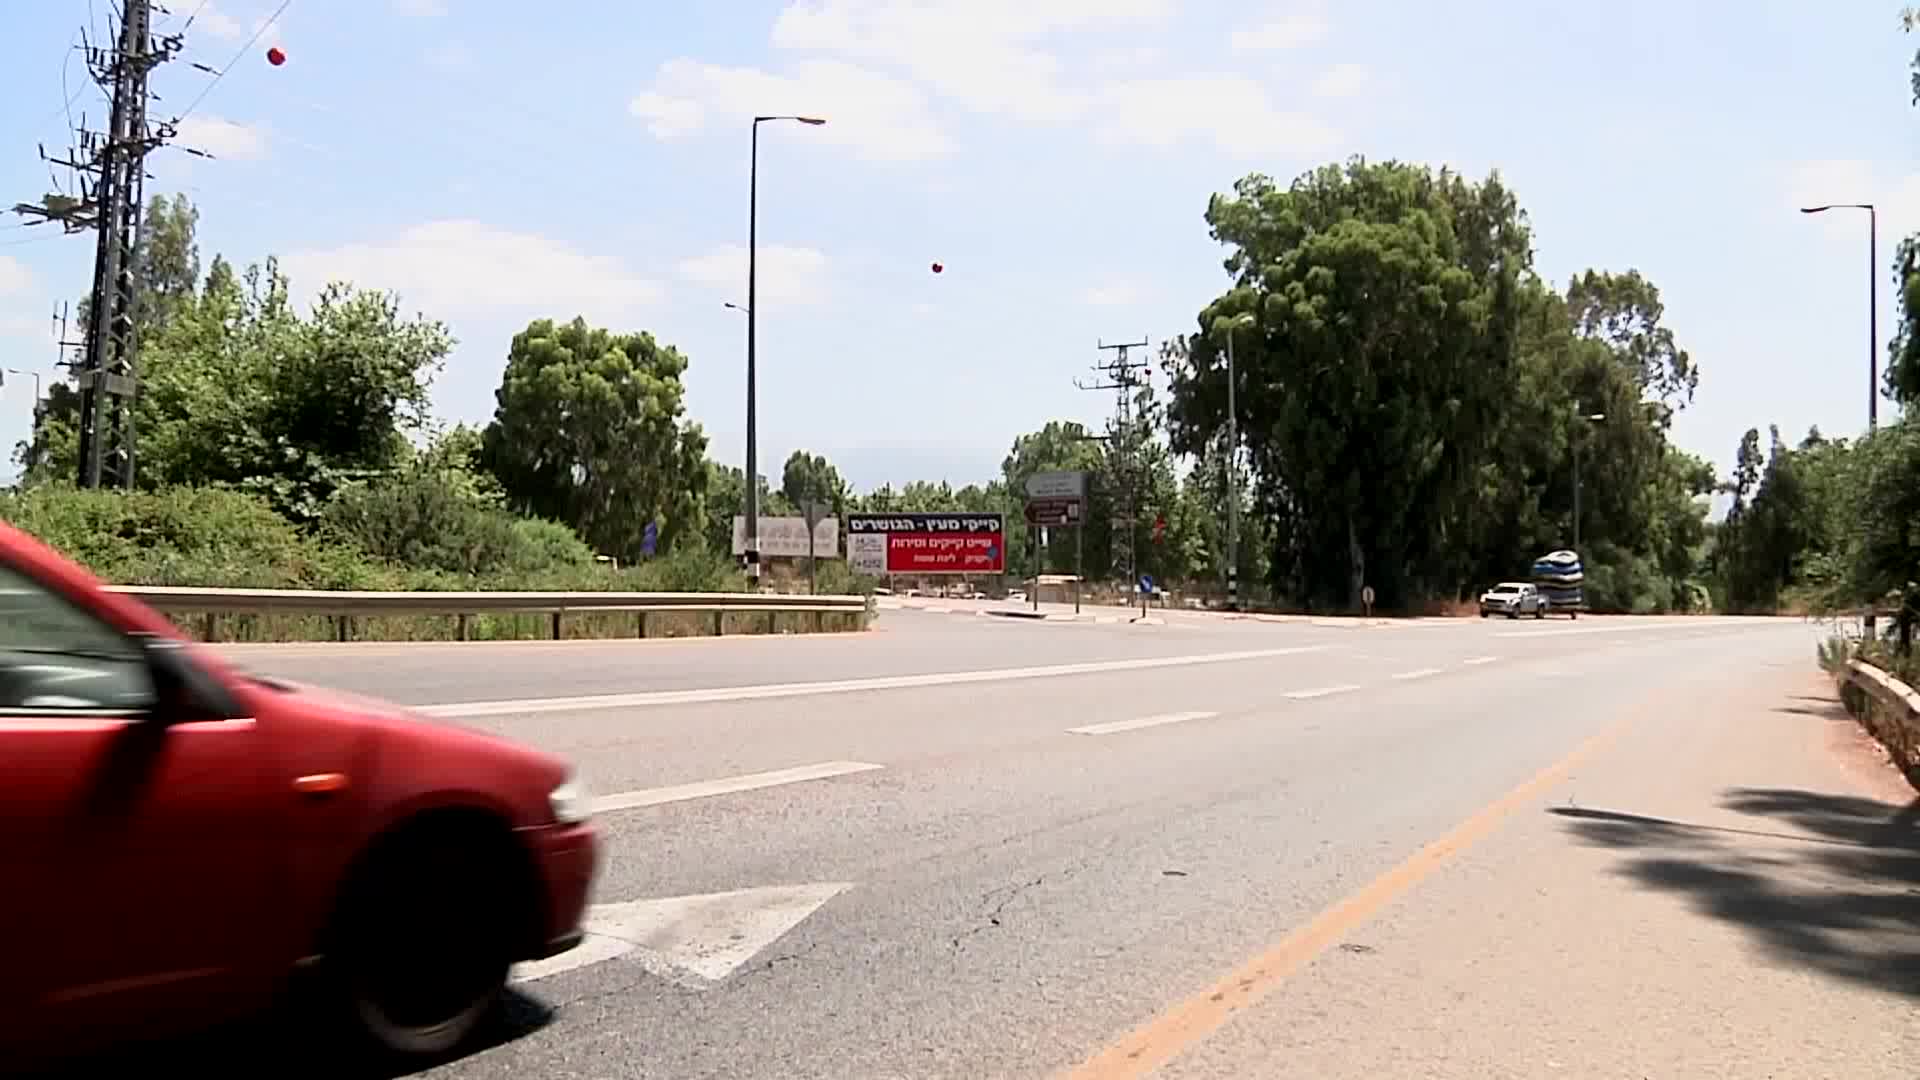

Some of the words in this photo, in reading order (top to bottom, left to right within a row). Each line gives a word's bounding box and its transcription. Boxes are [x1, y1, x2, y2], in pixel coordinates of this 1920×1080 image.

[850, 519, 915, 531] הגושרים
[962, 519, 1000, 532] קייקי
[929, 538, 964, 551] קייקים
